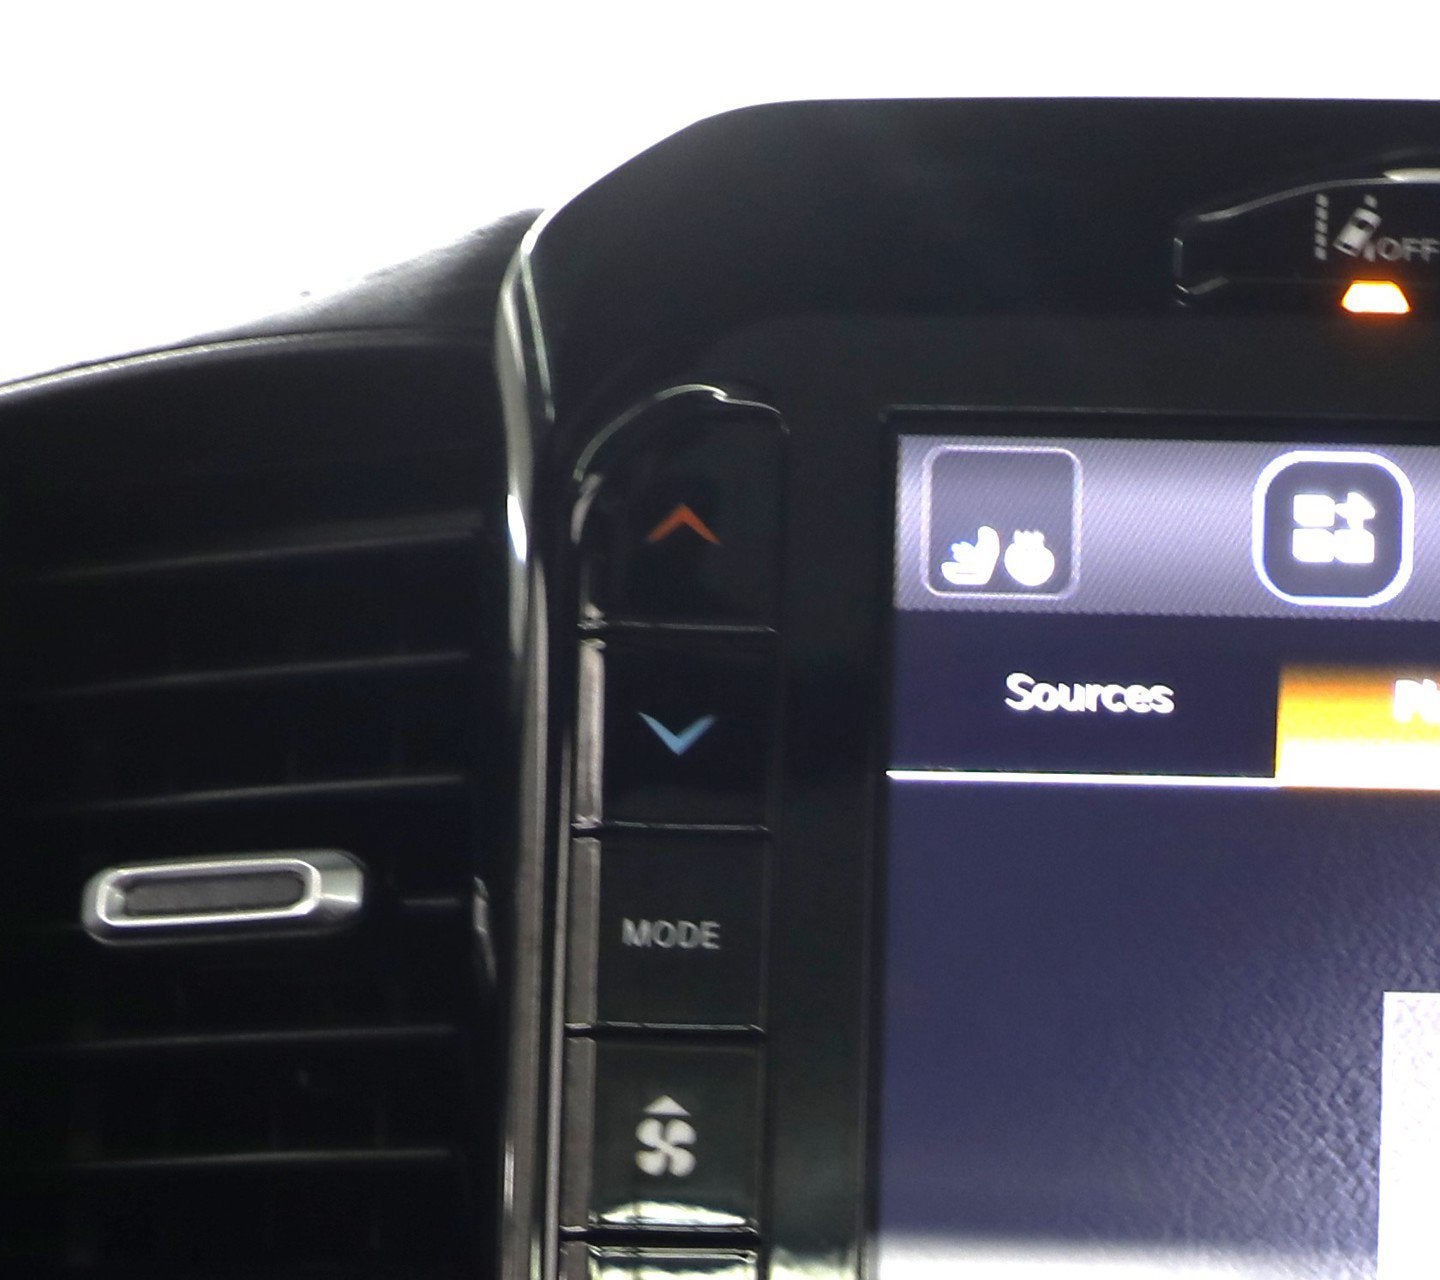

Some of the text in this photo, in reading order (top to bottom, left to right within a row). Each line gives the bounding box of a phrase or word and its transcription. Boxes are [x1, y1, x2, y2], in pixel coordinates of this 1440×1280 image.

[1377, 236, 1440, 265] OFF
[1005, 673, 1174, 715] Sources
[621, 918, 721, 950] MODE
